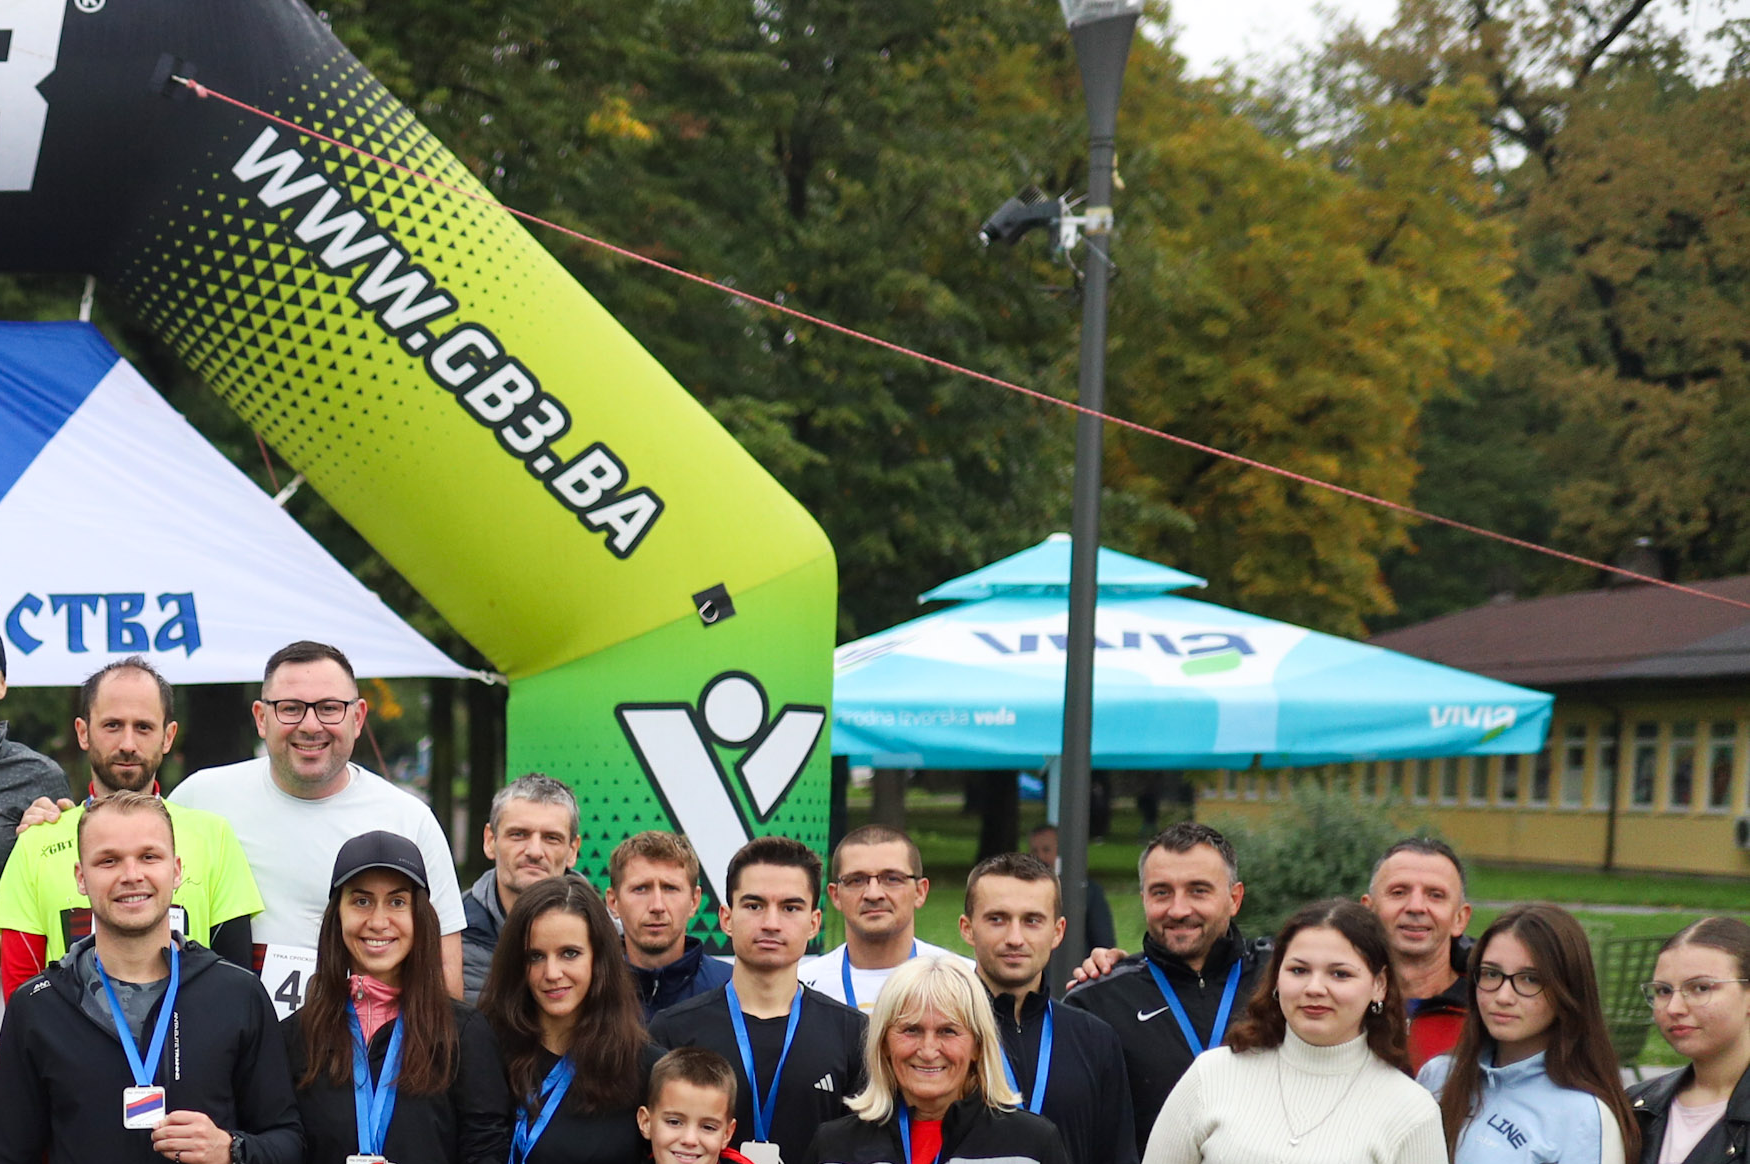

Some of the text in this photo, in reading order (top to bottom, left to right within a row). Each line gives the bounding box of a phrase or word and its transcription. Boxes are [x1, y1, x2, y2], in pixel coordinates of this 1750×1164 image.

[230, 124, 659, 554] WWW.GB3.BA
[973, 704, 1017, 727] voda
[1486, 1113, 1528, 1150] LINE
